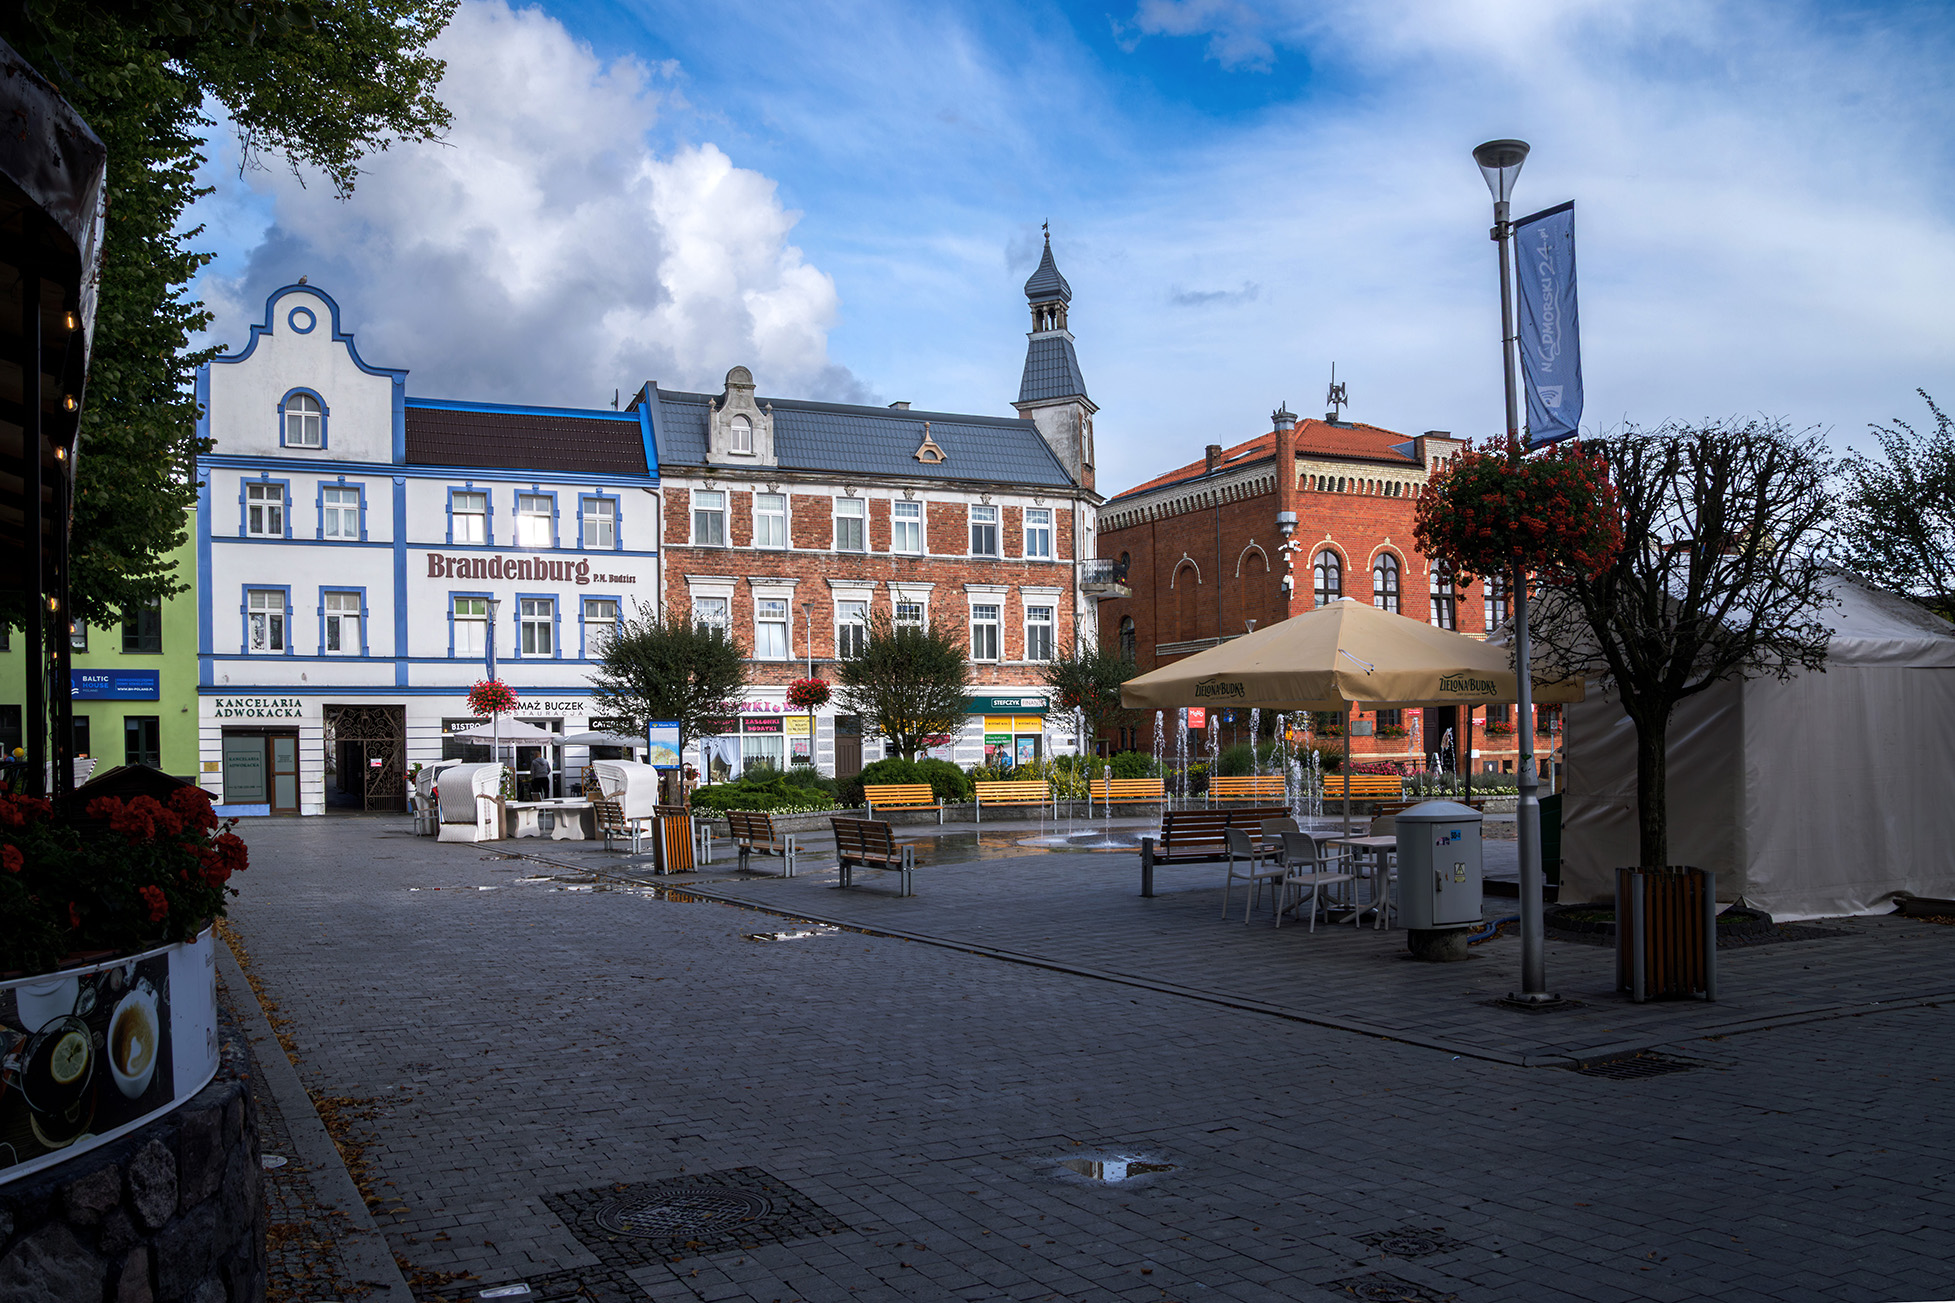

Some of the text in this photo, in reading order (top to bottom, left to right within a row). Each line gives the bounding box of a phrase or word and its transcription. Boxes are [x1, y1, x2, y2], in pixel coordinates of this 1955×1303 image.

[426, 553, 590, 585] Brandenburg
[1195, 682, 1245, 698] ZIELONA BUDKA
[1439, 678, 1497, 696] ZIELONA BUDKA
[215, 698, 302, 707] KANCELARIA
[545, 701, 584, 711] BUCZEK
[214, 708, 302, 717] ADWOKACKA
[451, 722, 481, 731] BISTRO
